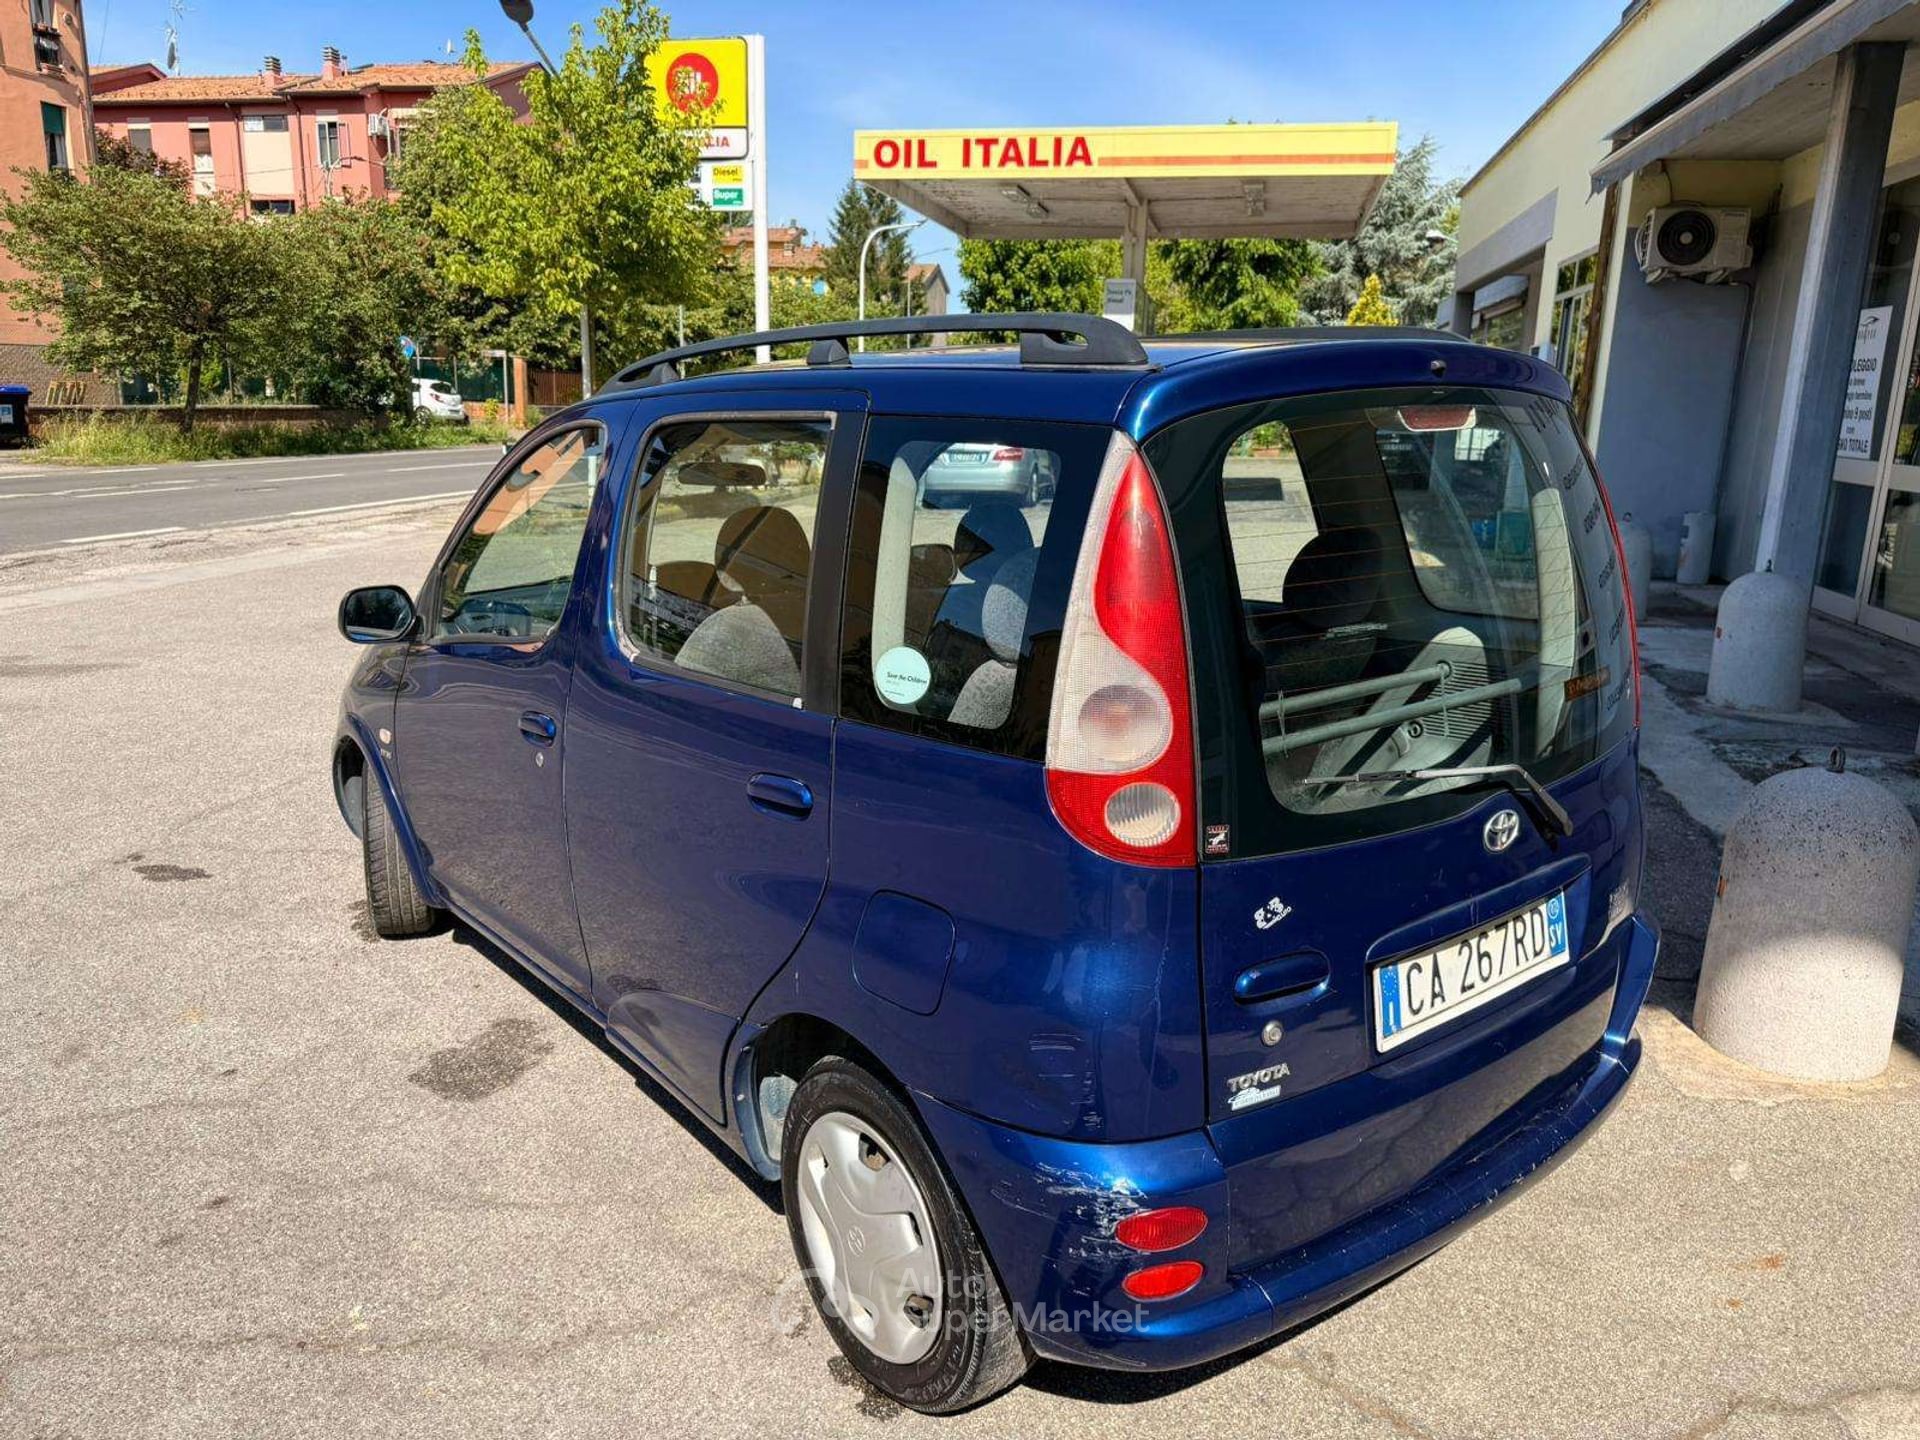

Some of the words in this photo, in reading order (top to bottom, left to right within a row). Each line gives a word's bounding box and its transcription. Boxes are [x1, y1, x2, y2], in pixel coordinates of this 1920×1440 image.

[874, 138, 938, 168] OIL
[963, 136, 1093, 168] ITALIA
[713, 167, 738, 176] Diesel
[713, 189, 738, 200] Super
[1549, 921, 1563, 948] SV
[1406, 952, 1446, 1016] CA
[1458, 908, 1546, 995] 267RD
[1389, 1001, 1394, 1026] I
[1227, 1062, 1290, 1092] TOYOTA
